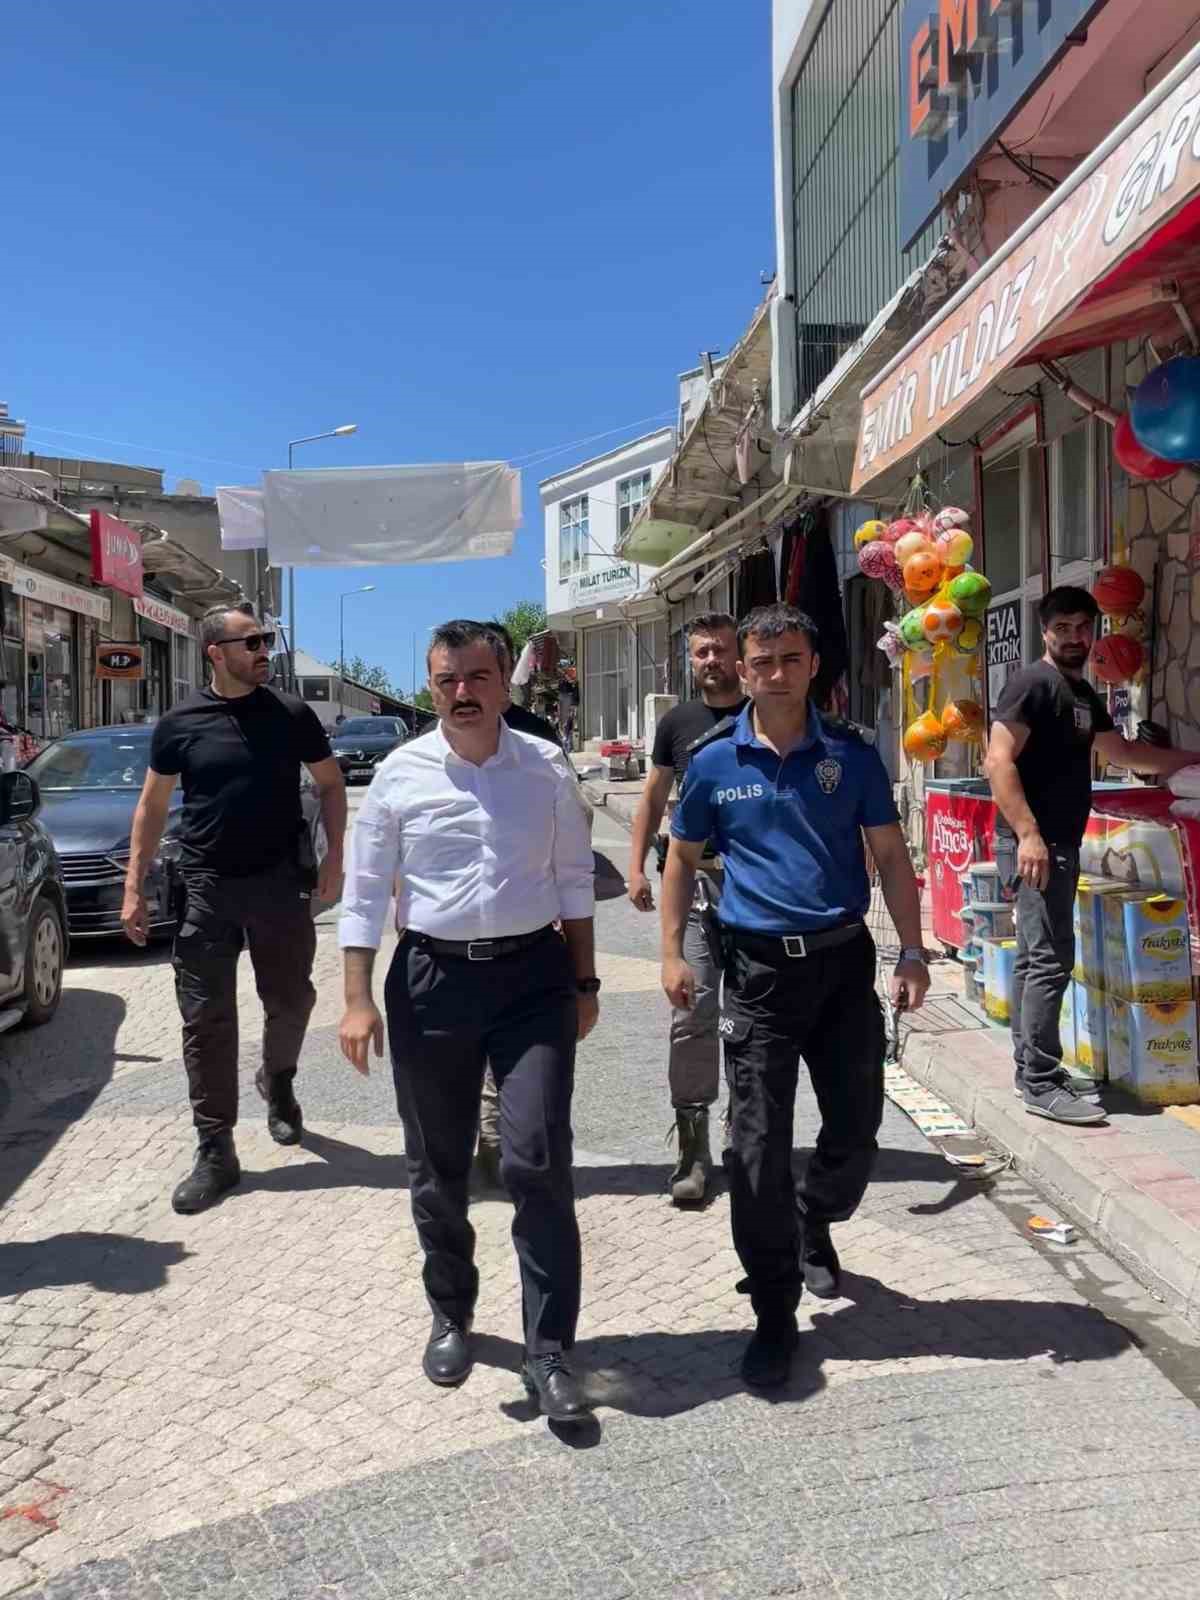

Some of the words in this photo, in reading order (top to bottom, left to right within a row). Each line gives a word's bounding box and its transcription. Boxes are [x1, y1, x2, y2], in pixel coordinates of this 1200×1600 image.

[927, 254, 1036, 422] YILDIZ
[987, 607, 1017, 641] EVA
[988, 637, 1020, 665] KTRİK
[716, 783, 764, 805] POLİS
